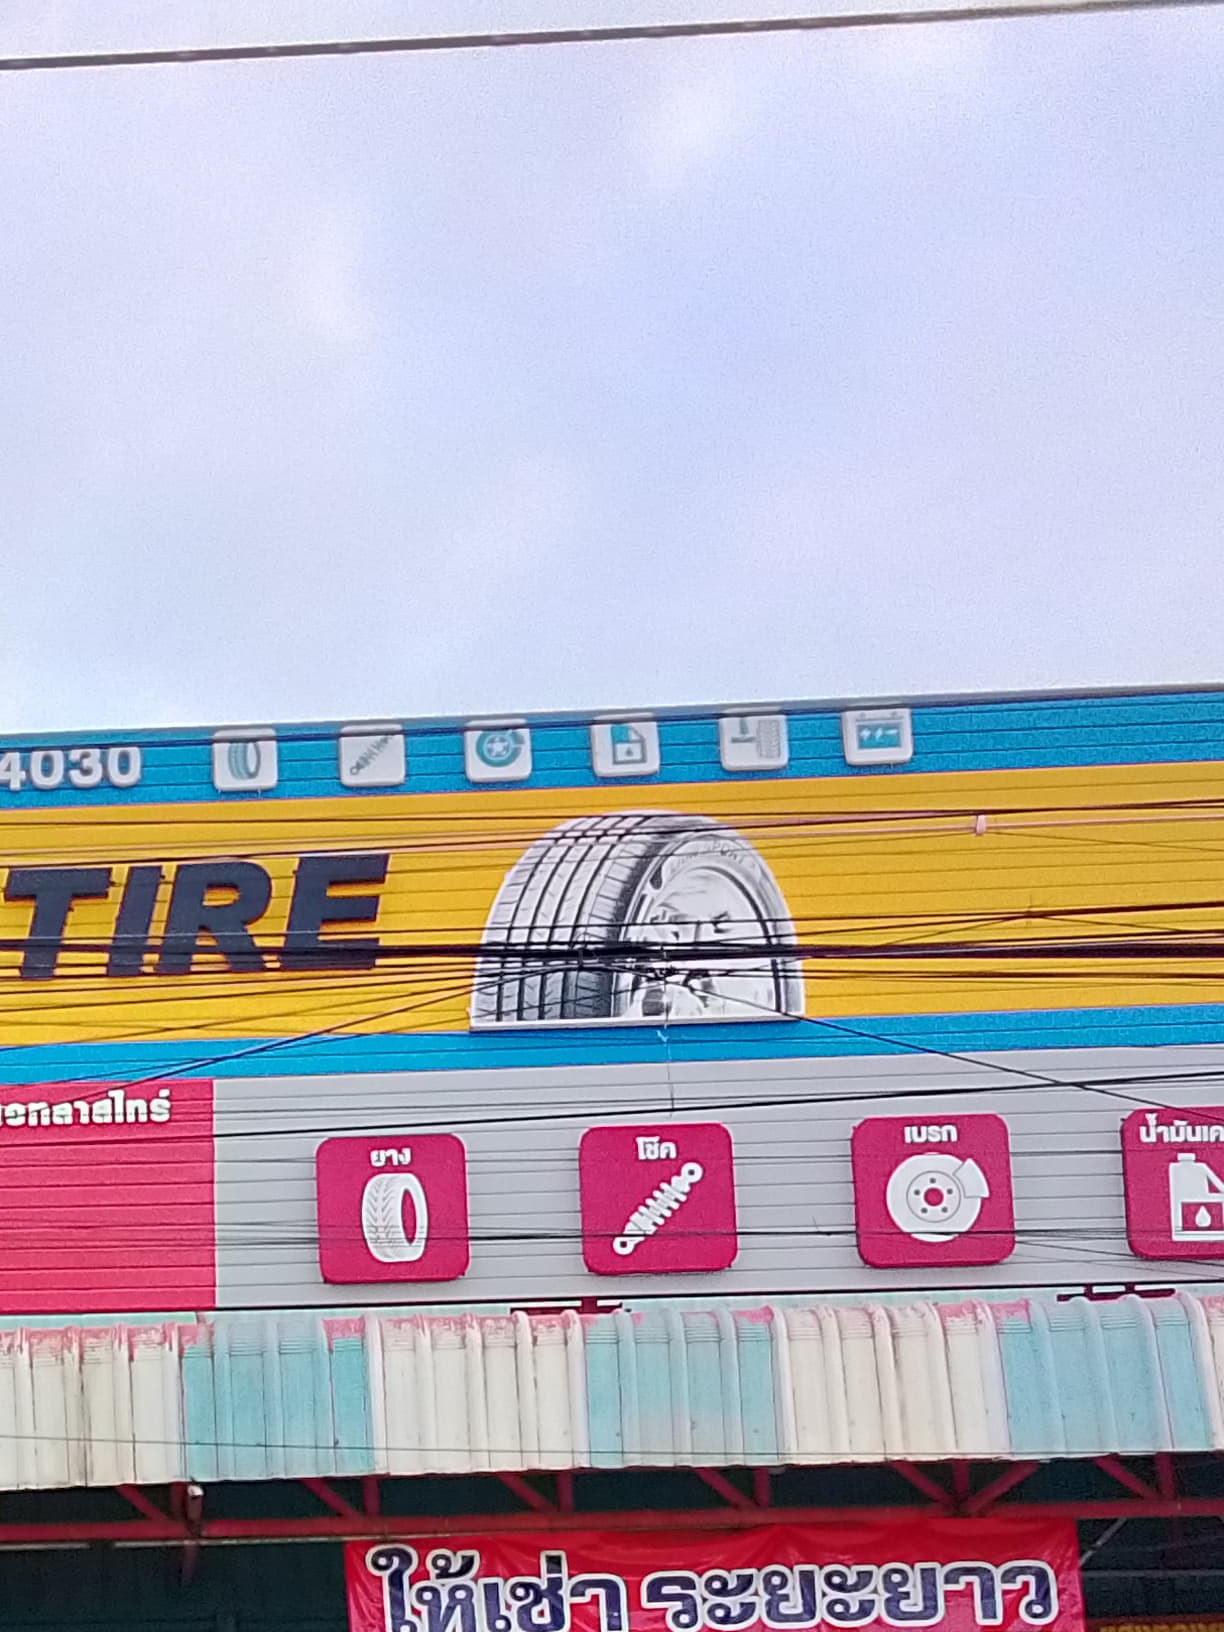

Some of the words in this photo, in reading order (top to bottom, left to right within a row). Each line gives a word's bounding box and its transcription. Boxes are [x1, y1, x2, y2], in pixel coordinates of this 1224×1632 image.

[3, 852, 391, 981] TIRE
[904, 1124, 958, 1143] เบรก
[370, 1147, 411, 1167] ยาง
